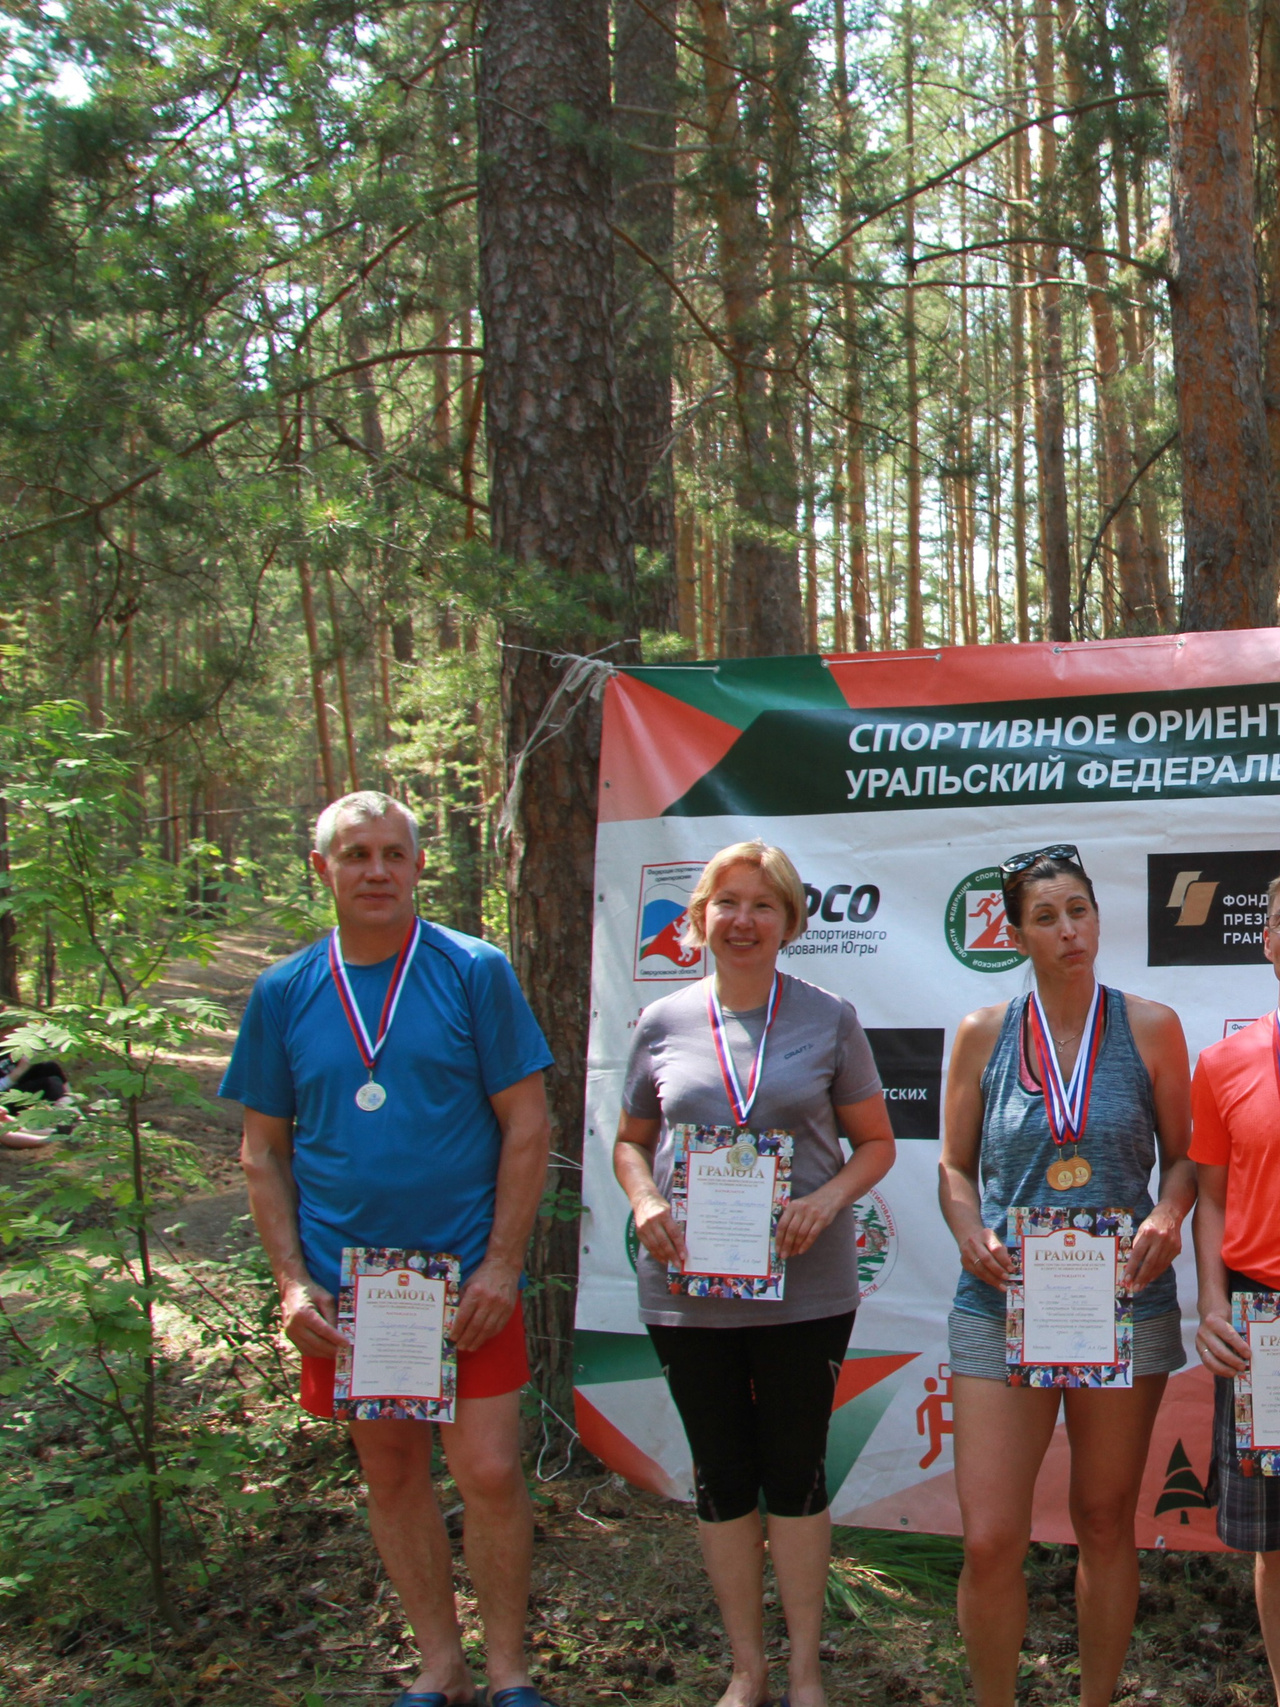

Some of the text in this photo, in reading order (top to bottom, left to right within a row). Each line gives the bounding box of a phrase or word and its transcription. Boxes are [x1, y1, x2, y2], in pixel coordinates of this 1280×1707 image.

[848, 713, 1117, 753] СПОРТИВНОЕ
[845, 754, 1066, 800] УРАЛЬСКИЙ
[949, 881, 972, 922] ФЕДЕРАЦИЯ
[1222, 893, 1270, 908] ФОНД
[805, 929, 887, 943] спортивного
[1223, 932, 1263, 945] ГРАН
[780, 940, 878, 958] ирования Югры
[972, 956, 1019, 969] ТЮМЕНСКОЙ
[881, 1088, 928, 1100] ТСКИХ
[698, 1164, 765, 1179] ГРАМОТА
[869, 1188, 896, 1237] НТИРОВАНИЯ
[1034, 1249, 1106, 1261] ГРАМОТА
[367, 1288, 436, 1302] ГРАМОТА
[859, 1283, 878, 1298] АСТИ
